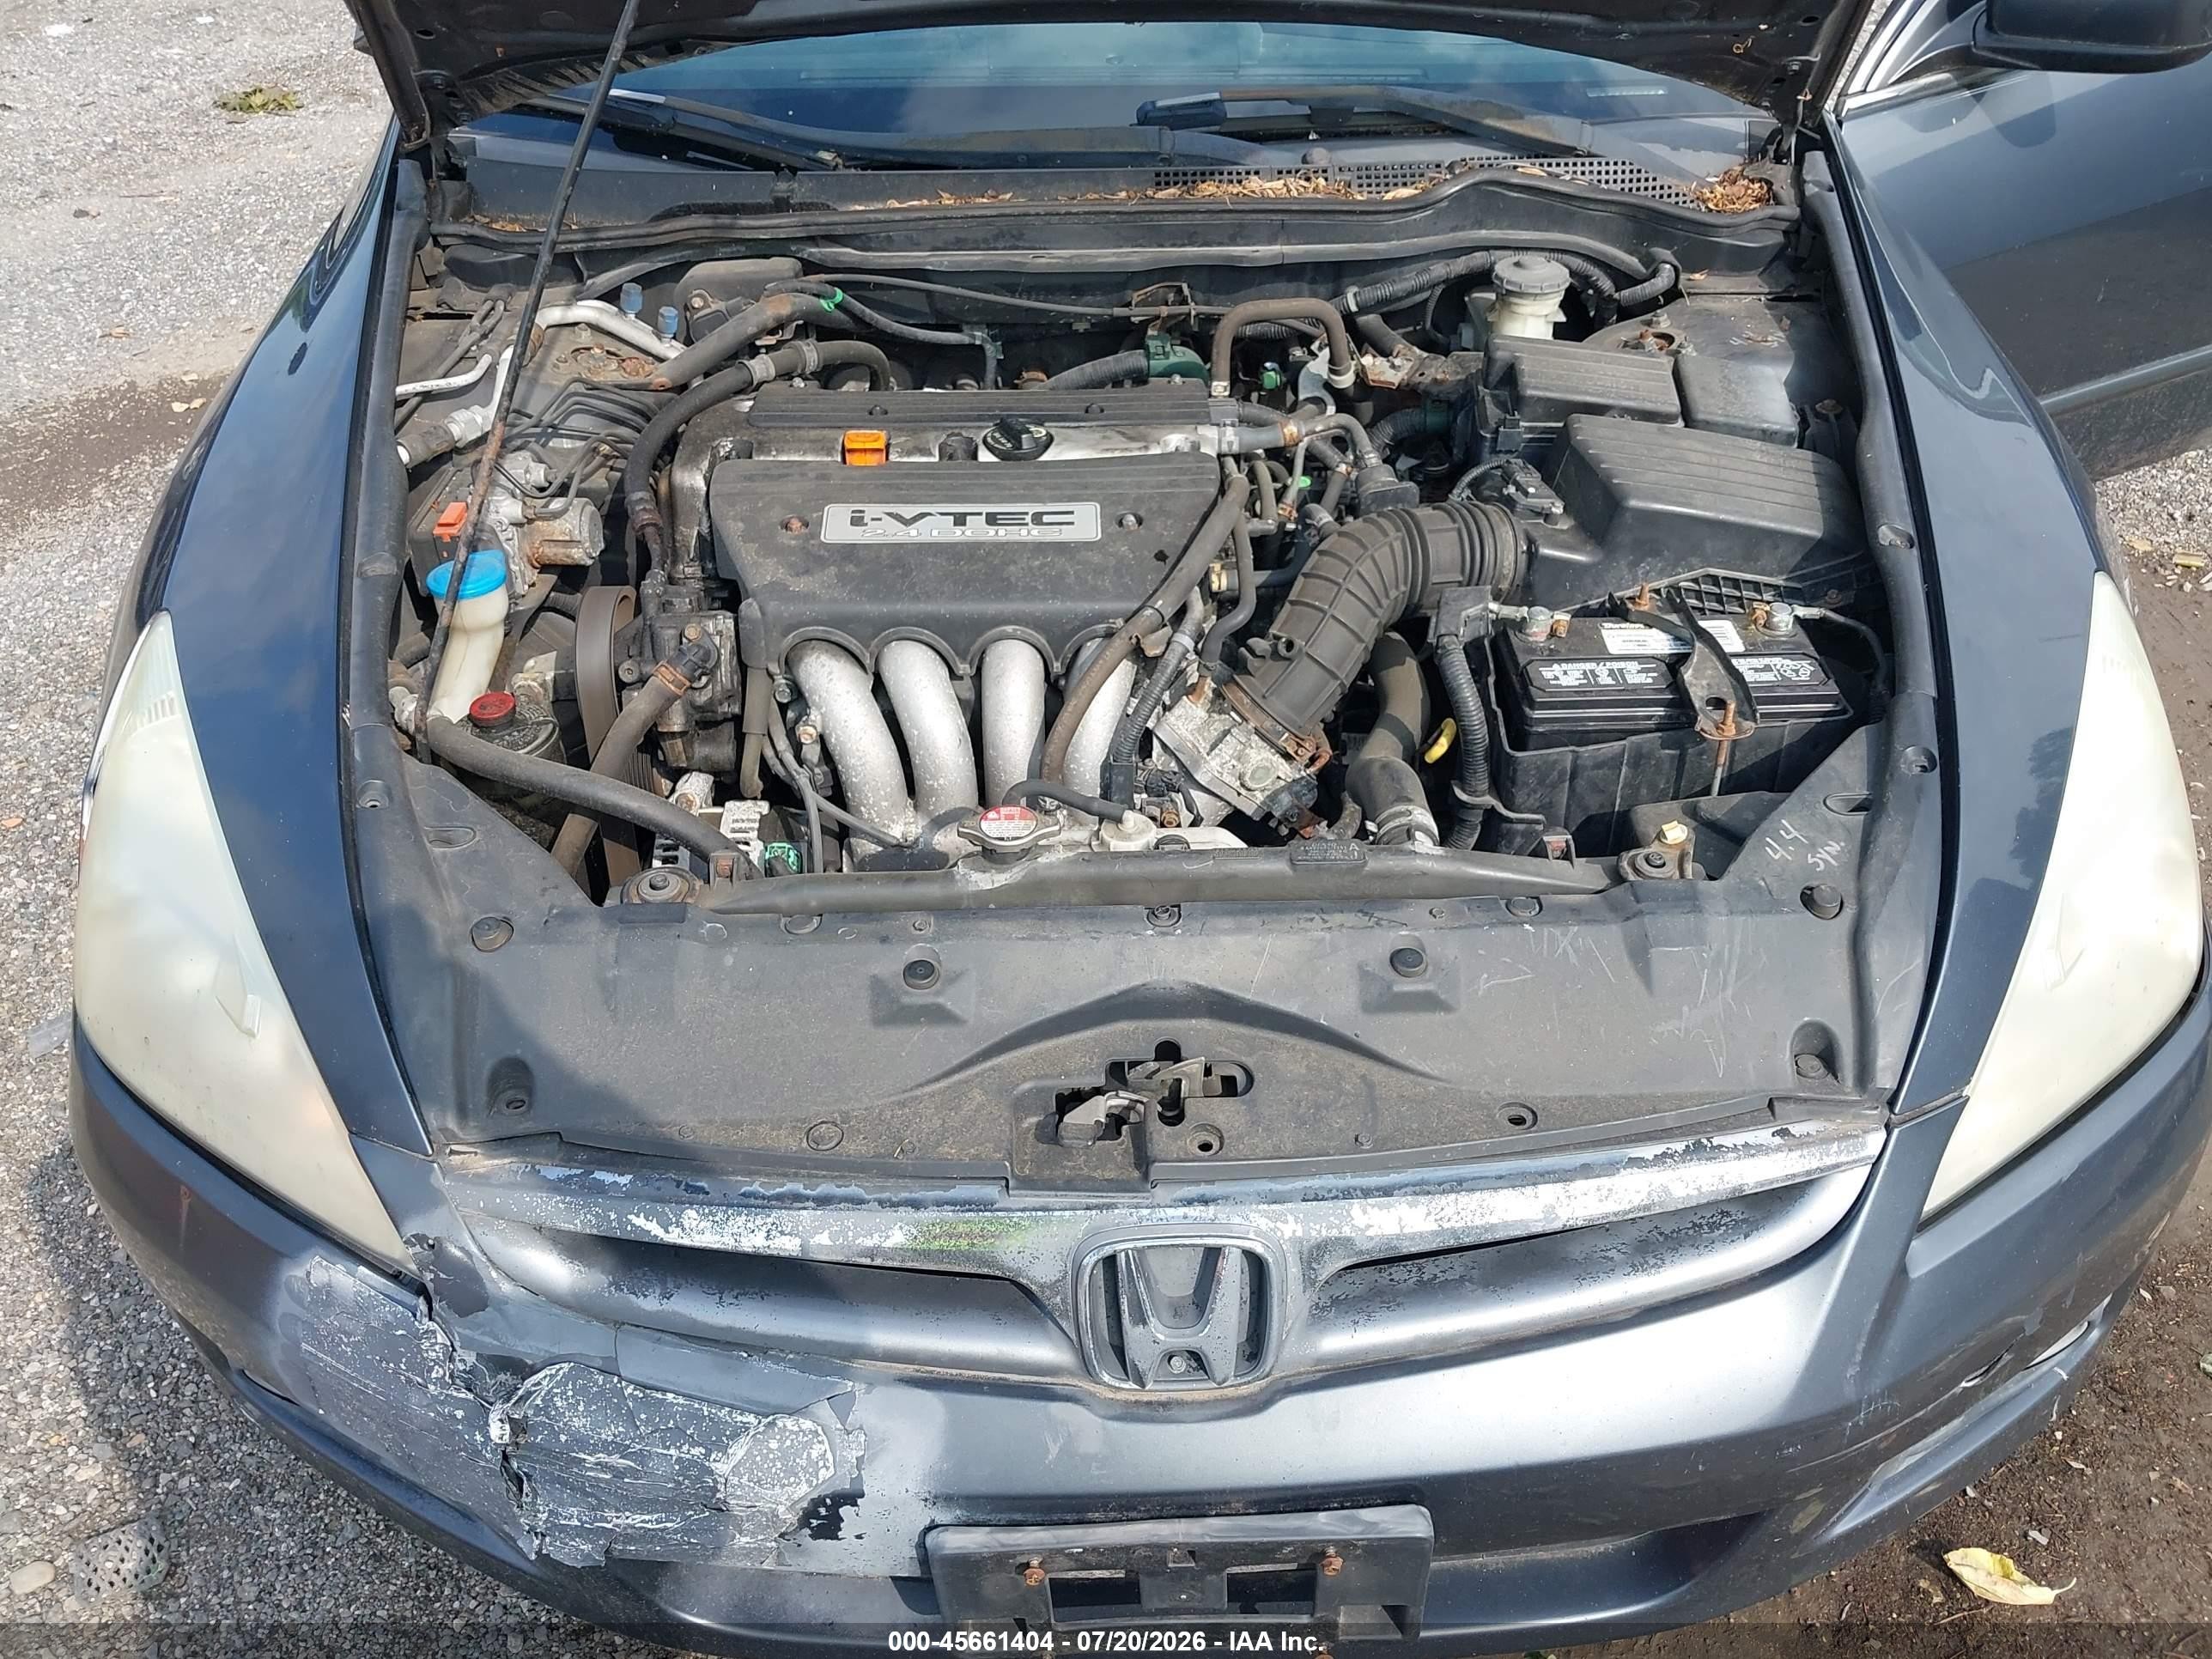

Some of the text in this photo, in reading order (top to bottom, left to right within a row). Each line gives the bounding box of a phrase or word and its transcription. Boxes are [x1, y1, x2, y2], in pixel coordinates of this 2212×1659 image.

[849, 508, 1076, 528] i-VTEC
[860, 528, 1062, 538] 2.4 DOHC
